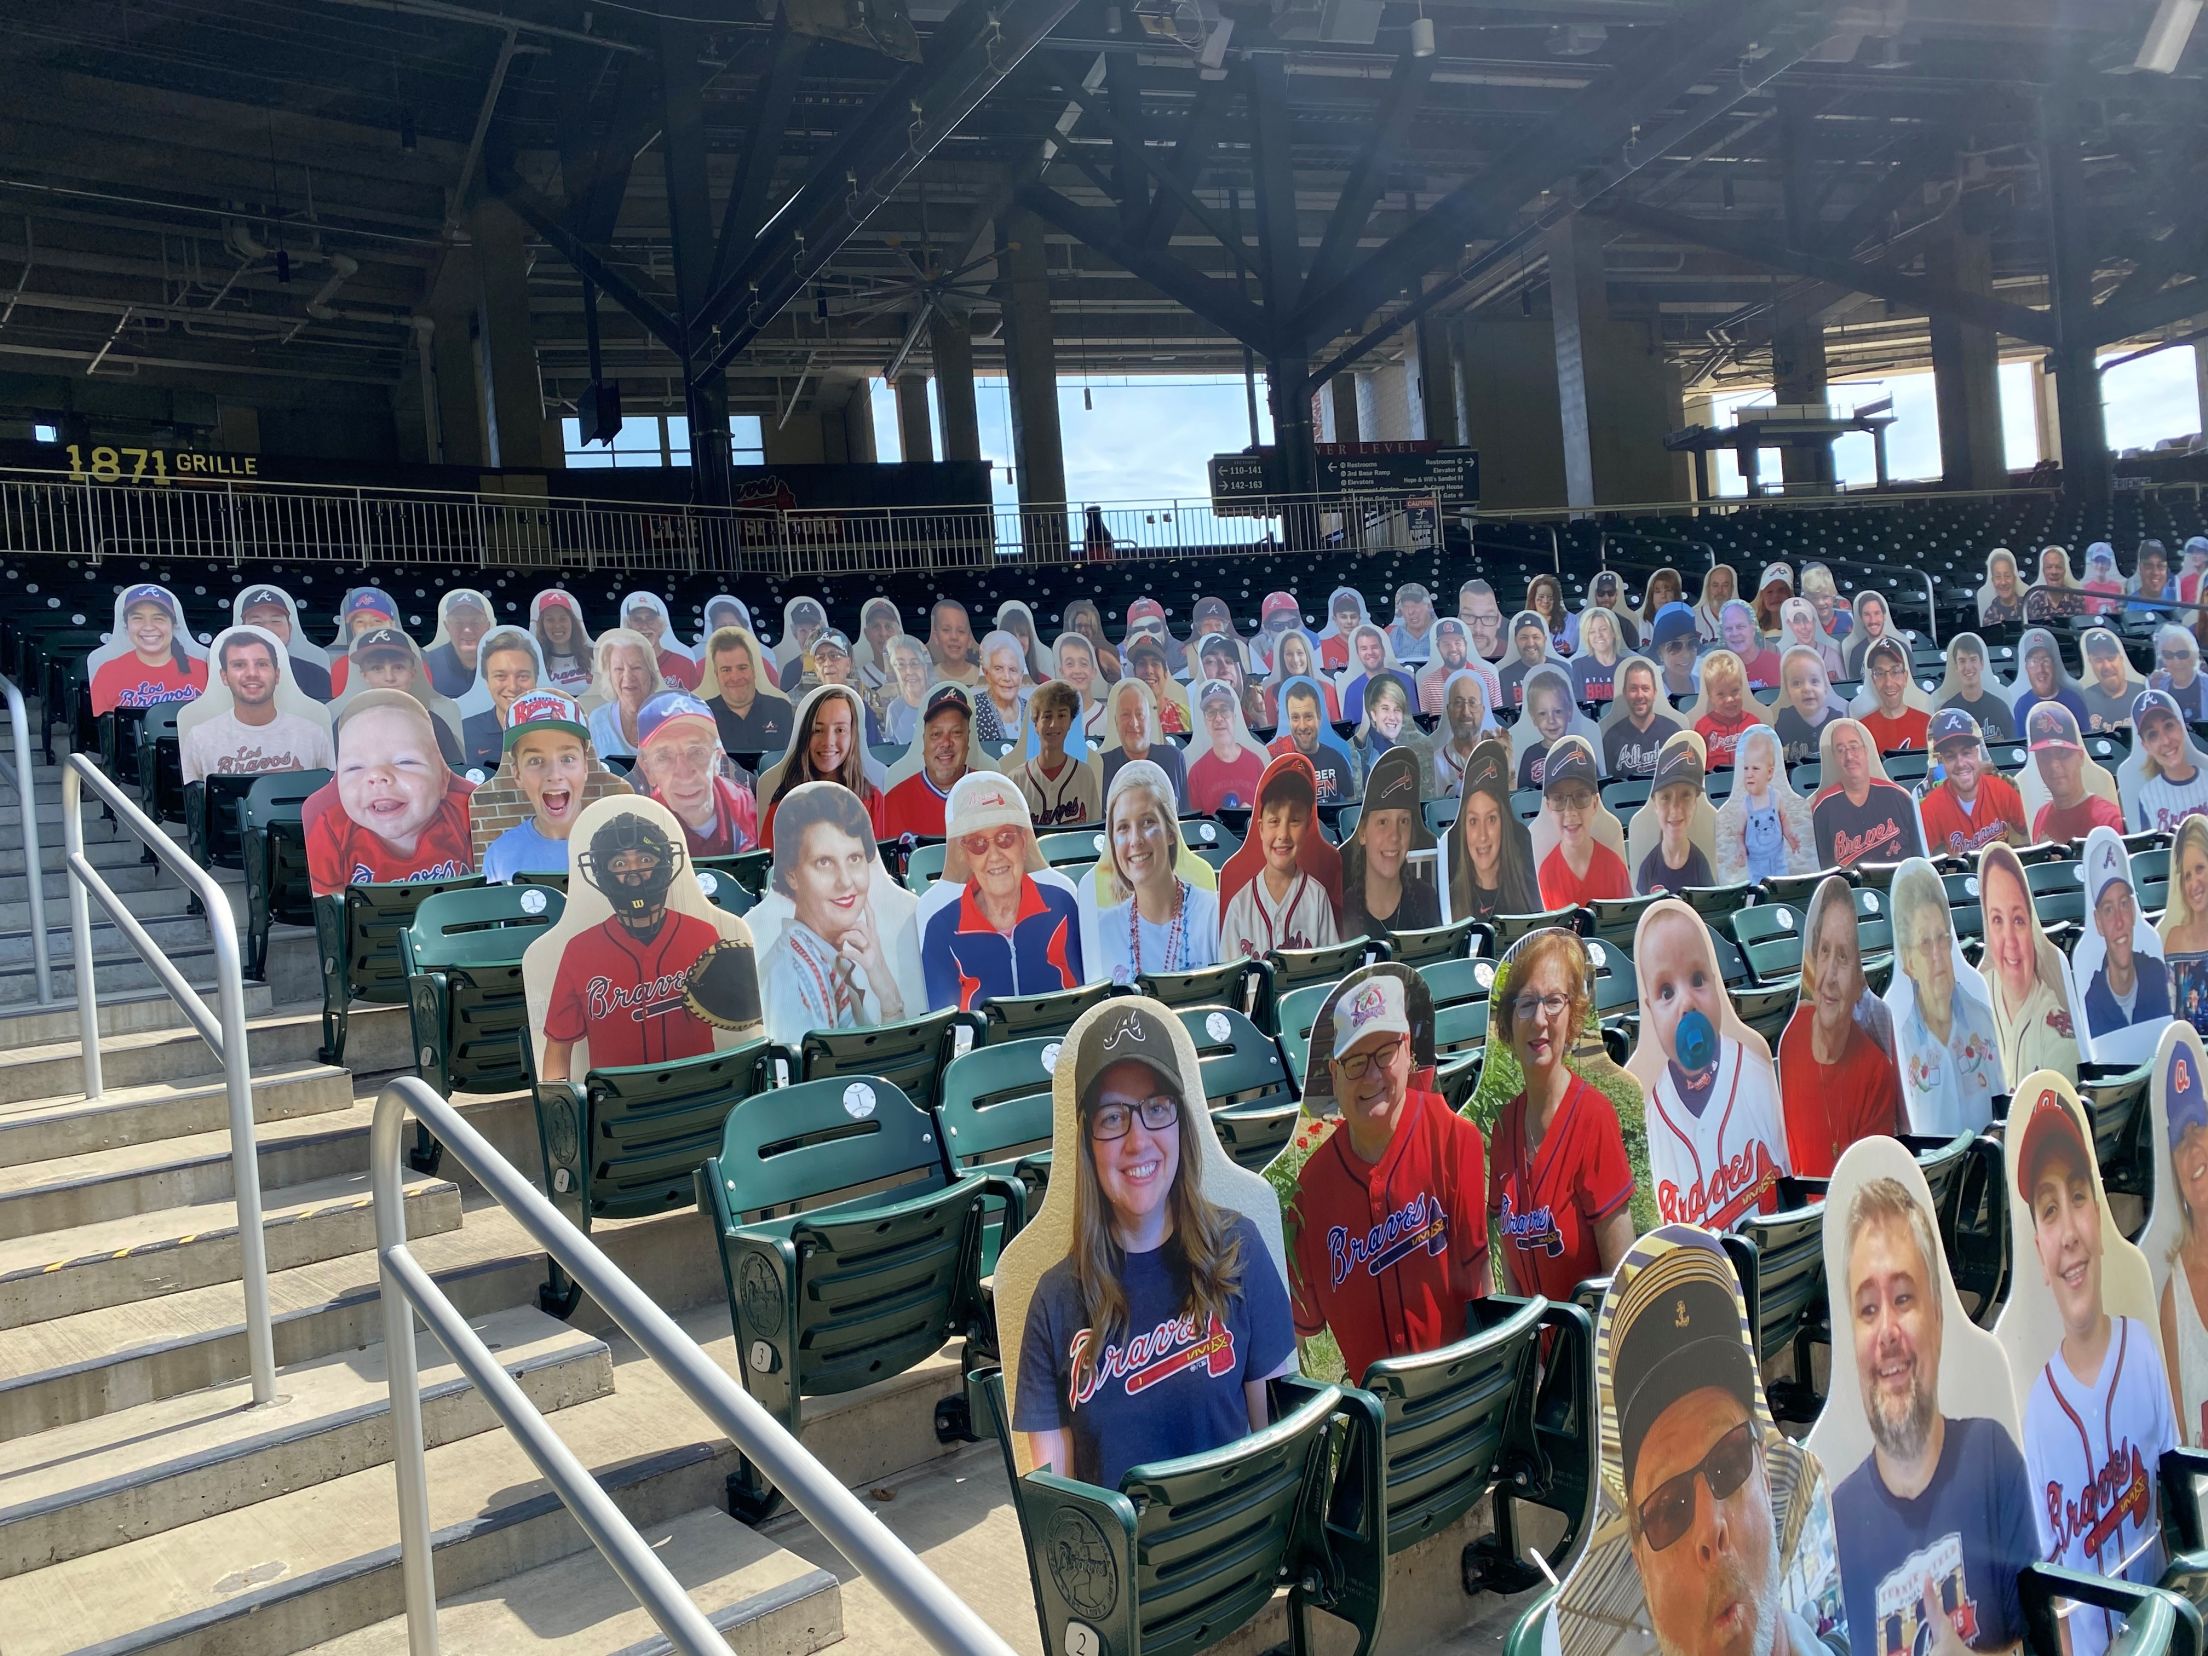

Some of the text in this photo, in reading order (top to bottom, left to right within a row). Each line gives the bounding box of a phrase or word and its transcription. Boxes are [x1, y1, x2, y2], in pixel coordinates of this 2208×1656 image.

[1360, 441, 1417, 455] LEVEL
[66, 444, 259, 486] 1871 GRILLE
[1230, 466, 1263, 475] 110-141
[1230, 481, 1263, 490] 142-163
[254, 590, 273, 603] A
[367, 629, 392, 645] A
[119, 684, 194, 708] Bravos
[138, 681, 164, 695] Los
[661, 696, 694, 718] A
[1944, 715, 1963, 730] A
[217, 750, 292, 775] Bravos
[235, 744, 263, 762] Los
[1834, 816, 1901, 862] Braves
[1949, 818, 2008, 853] Braves
[1103, 1009, 1147, 1051] A
[1658, 1137, 1755, 1226] Braves
[1500, 1192, 1551, 1236] Braves
[1326, 1191, 1427, 1293] Braves
[757, 1347, 765, 1366] 3
[2046, 1435, 2131, 1554] Braves
[1076, 1631, 1087, 1656] 2
